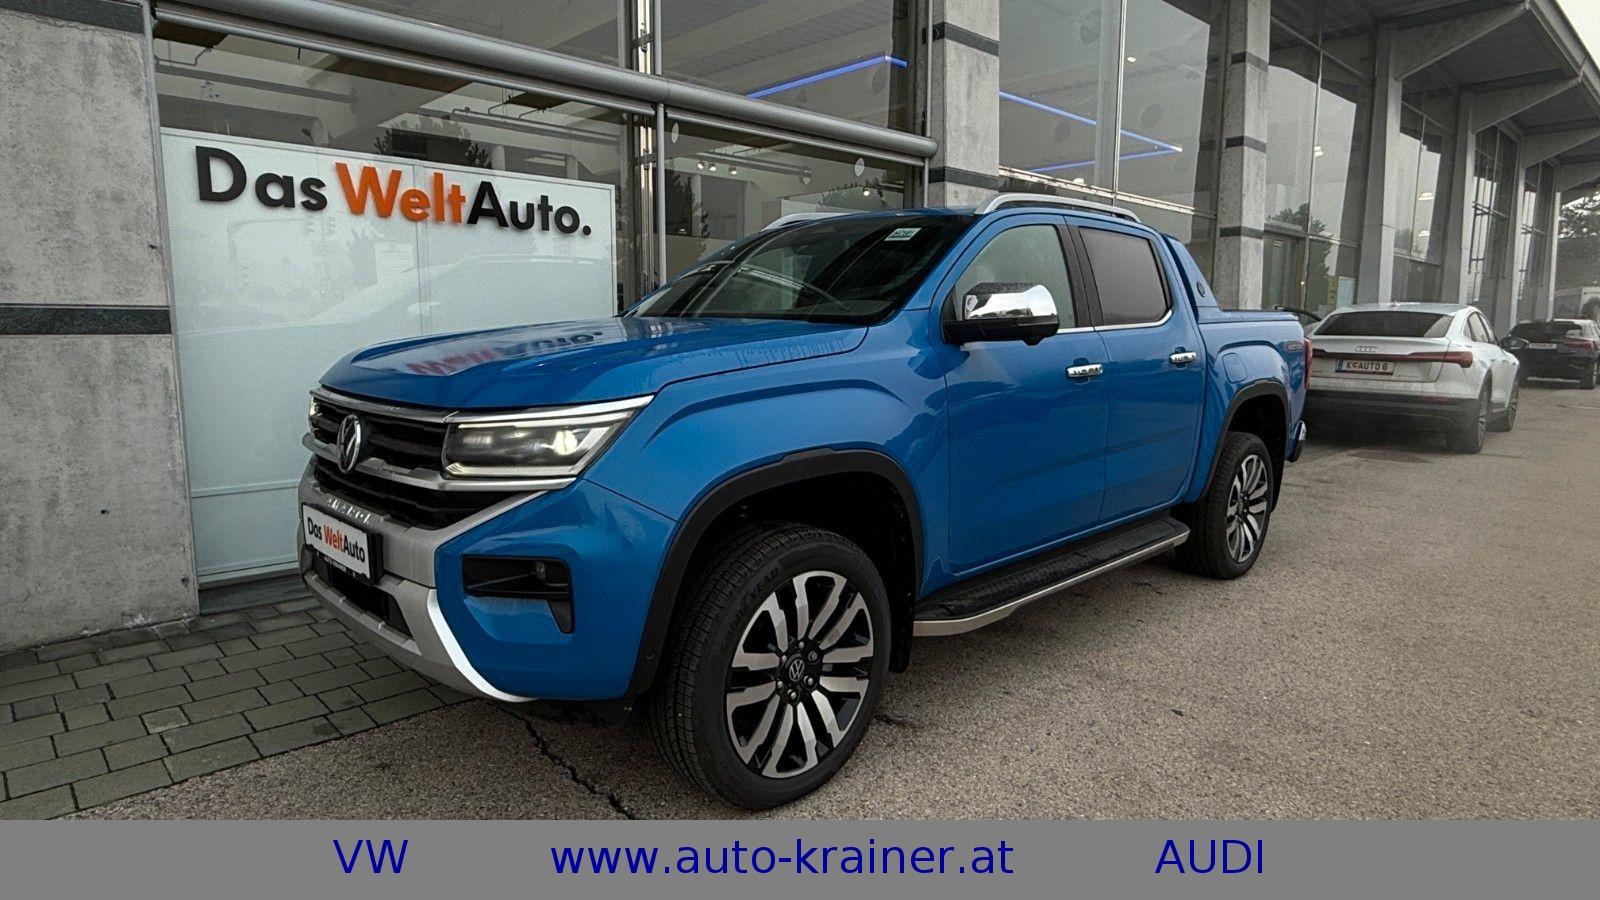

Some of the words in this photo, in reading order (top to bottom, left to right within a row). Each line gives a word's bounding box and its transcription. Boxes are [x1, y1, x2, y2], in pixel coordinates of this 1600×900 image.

[195, 145, 328, 211] Das
[335, 162, 593, 236] WeltAuto.
[307, 516, 322, 541] Das
[323, 524, 365, 563] WeltAuto
